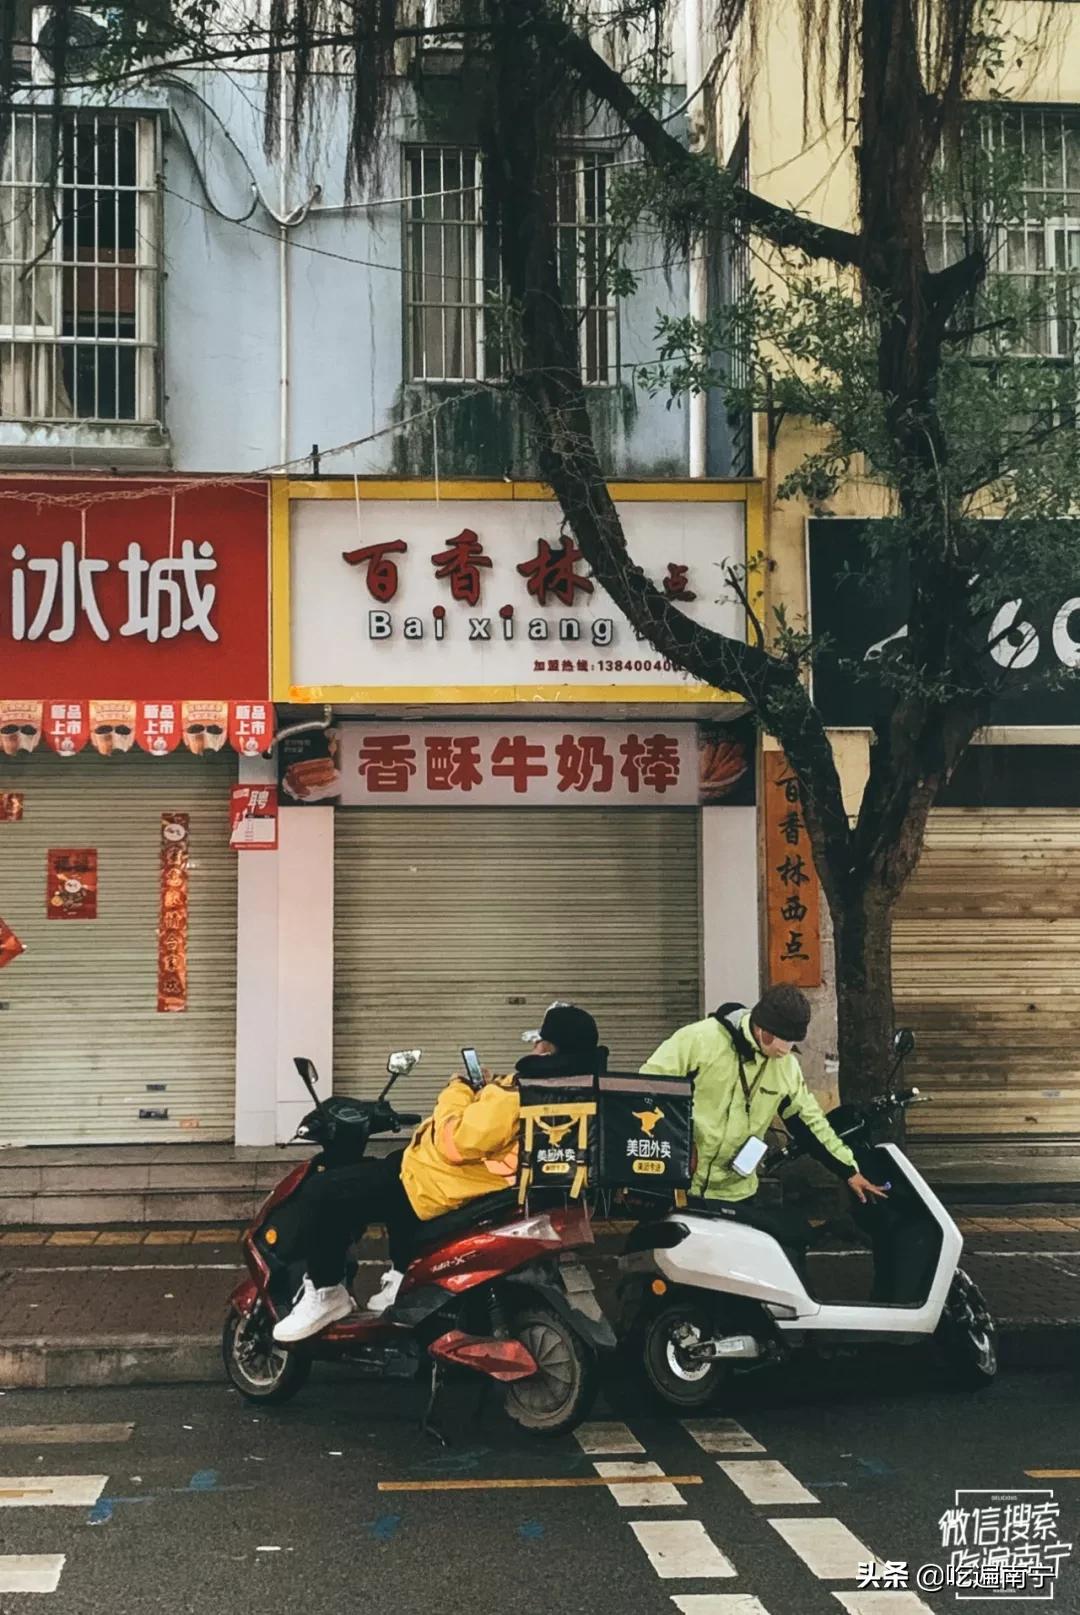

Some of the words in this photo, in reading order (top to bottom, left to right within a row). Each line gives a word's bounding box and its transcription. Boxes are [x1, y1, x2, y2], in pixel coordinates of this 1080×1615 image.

[12, 539, 219, 642] 冰城
[367, 605, 446, 641] Bai
[468, 604, 614, 647] xiang
[533, 659, 684, 673] 加盟热线:13840040
[143, 720, 175, 736] 上市
[235, 720, 267, 736] 上市
[357, 732, 681, 794] 香酥牛奶棒
[774, 776, 811, 962] 百香林西点
[536, 1148, 577, 1163] 美团外卖
[626, 1137, 673, 1159] 美团外卖
